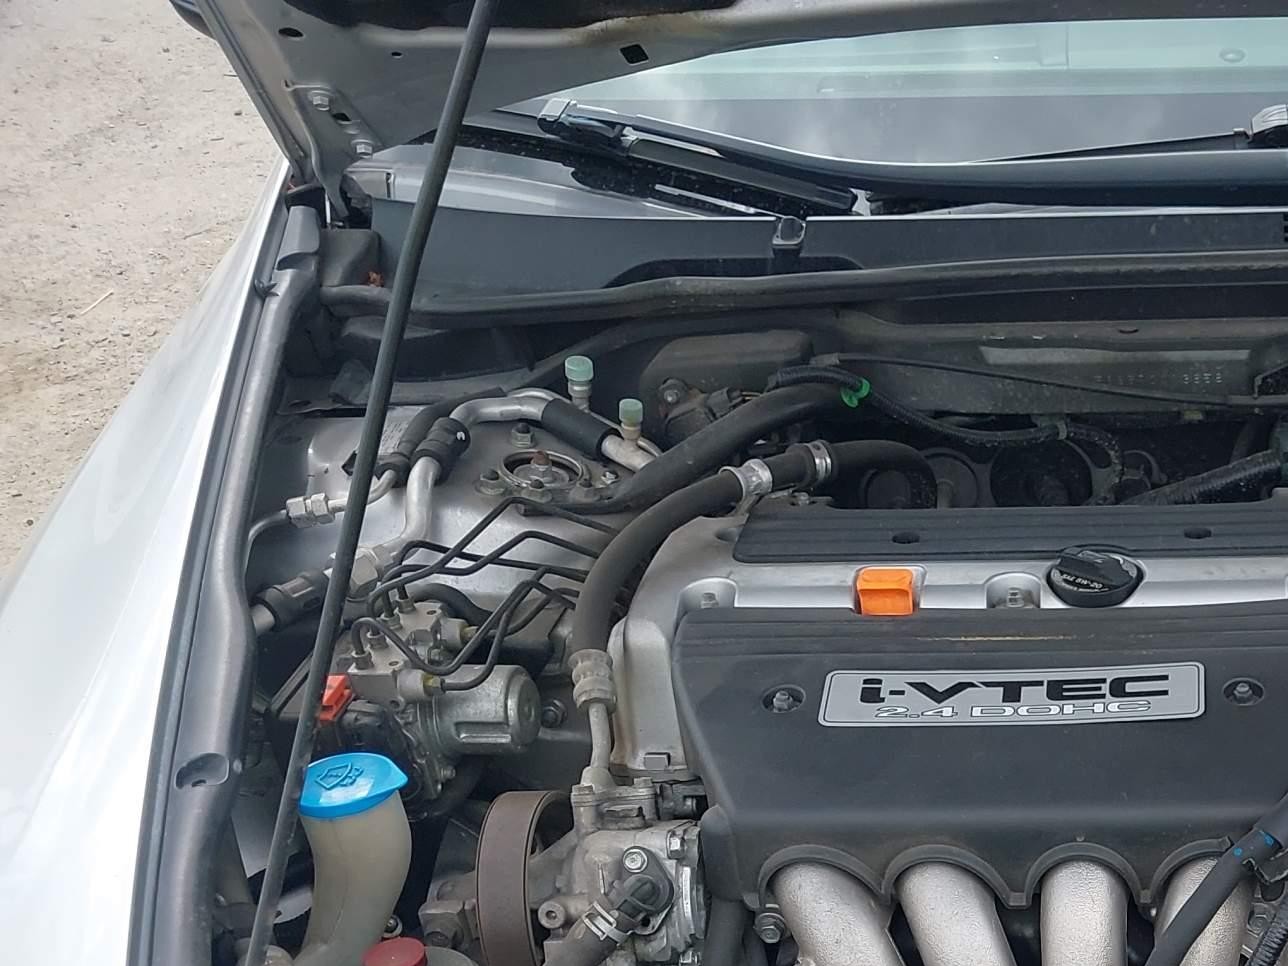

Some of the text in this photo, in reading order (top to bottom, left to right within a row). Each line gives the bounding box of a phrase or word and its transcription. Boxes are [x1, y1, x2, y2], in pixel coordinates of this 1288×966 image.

[859, 674, 1169, 705] i-VTEC
[874, 700, 1152, 719] 2.4 DOHC
